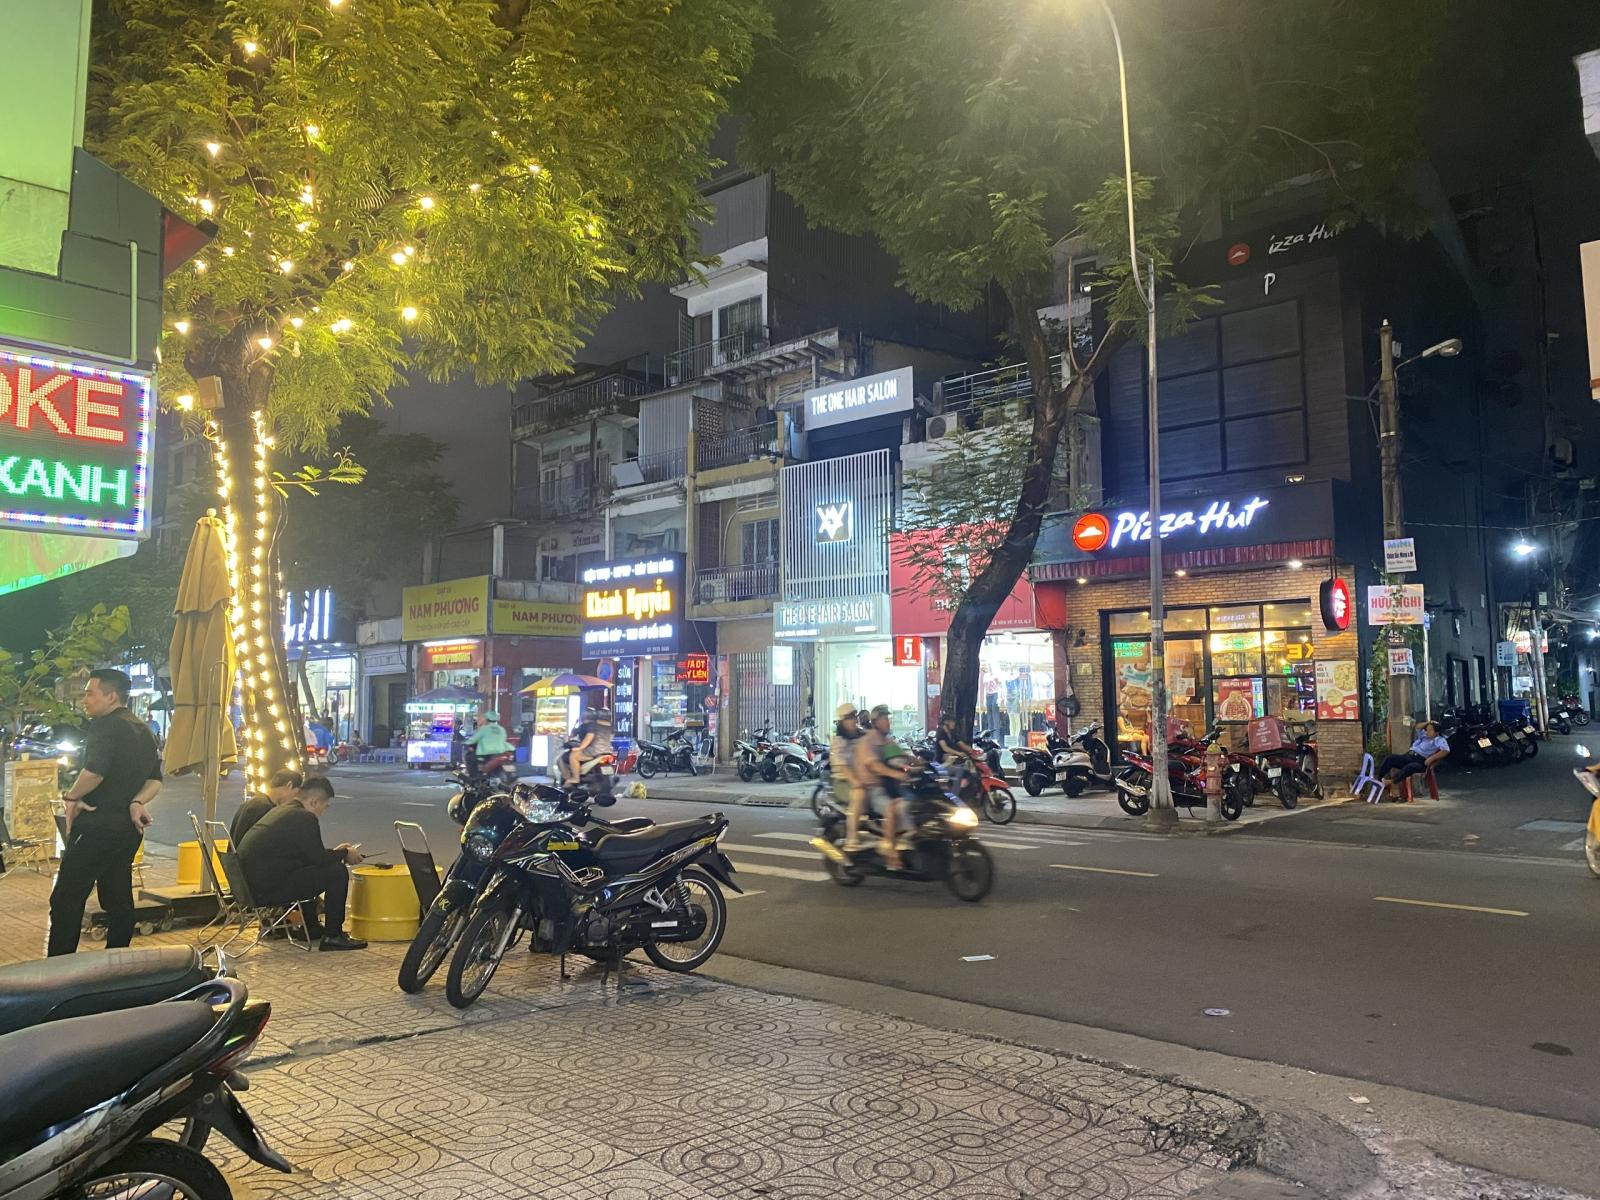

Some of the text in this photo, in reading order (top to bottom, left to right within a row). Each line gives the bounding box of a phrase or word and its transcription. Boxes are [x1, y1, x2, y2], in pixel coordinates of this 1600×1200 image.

[0, 368, 124, 442] KE
[811, 378, 897, 416] THE ONE HAIR SALON
[1111, 496, 1270, 549] Pizza Hut
[409, 596, 480, 620] NAM PHƯƠNG
[512, 611, 582, 625] NAM PHƯƠN
[781, 606, 797, 626] THE
[841, 600, 873, 622] SALON
